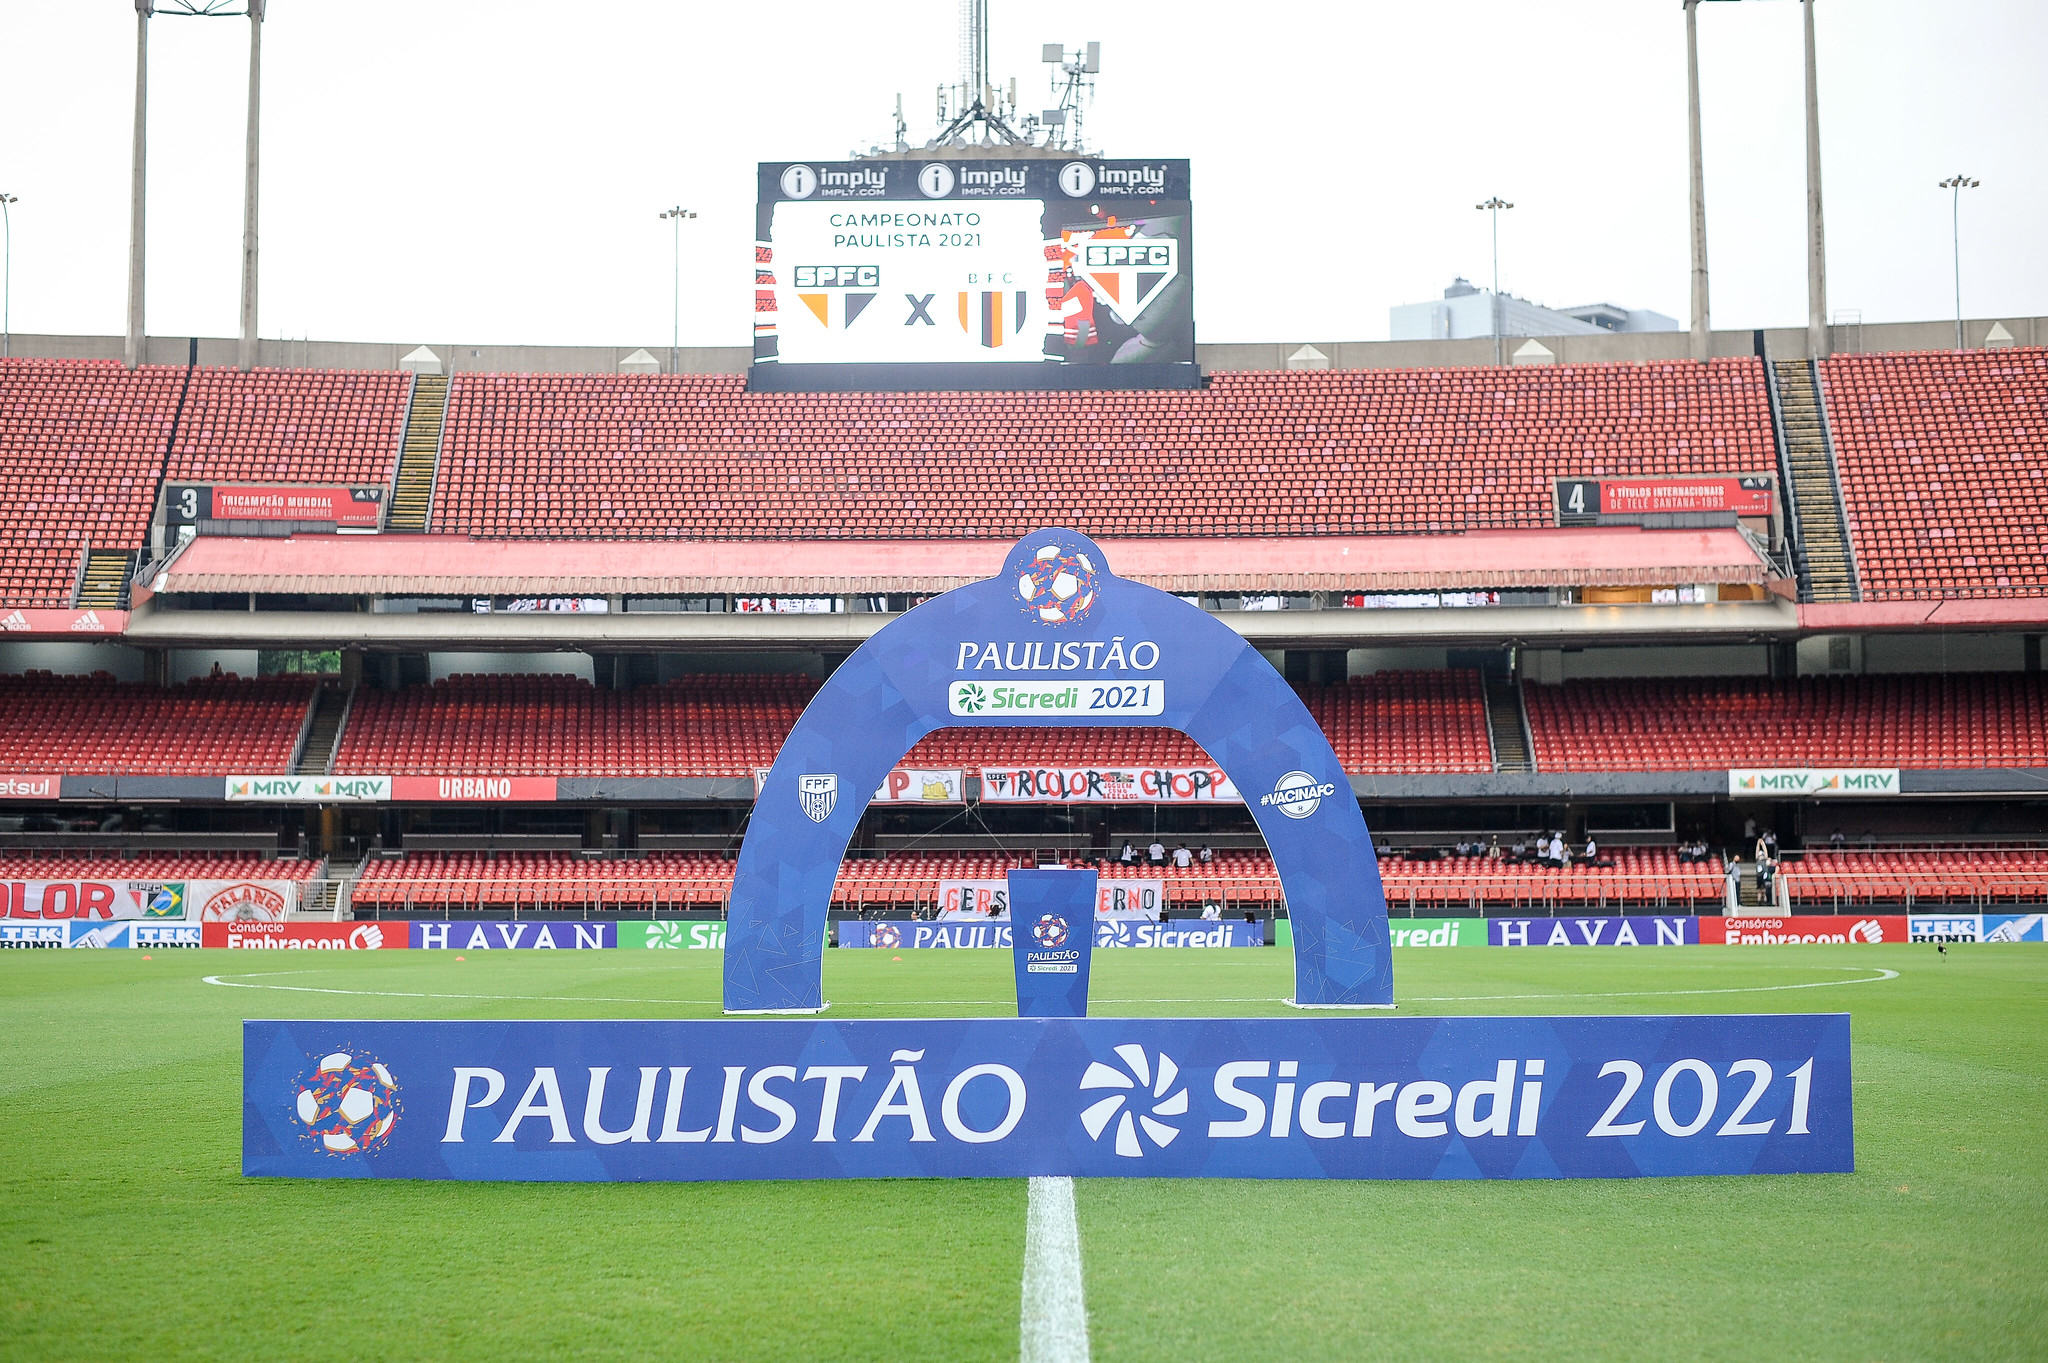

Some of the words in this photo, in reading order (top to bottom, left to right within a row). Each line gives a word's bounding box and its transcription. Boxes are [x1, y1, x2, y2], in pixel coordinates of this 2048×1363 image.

[820, 167, 886, 188] imply
[960, 166, 1027, 188] imply
[1098, 165, 1165, 187] imply
[821, 188, 886, 196] IMPLY.COM
[961, 187, 1026, 195] IMPLY.COM
[1100, 186, 1165, 194] IMPLY.COM
[829, 212, 981, 227] CAMPEONATO
[834, 233, 931, 248] PAULISTA
[938, 233, 981, 247] 2021
[1088, 246, 1168, 265] SPFC
[796, 265, 878, 287] SPFC
[1568, 483, 1585, 514] 4
[1617, 485, 1652, 498] TÍTULOS
[1653, 485, 1725, 497] INTERNACIONAIS
[181, 488, 198, 519] 3
[221, 494, 284, 507] TRICAMPEÃO
[287, 496, 333, 508] MUNDIAL
[955, 635, 1161, 671] PAULISTÃO
[991, 687, 1079, 709] Sicredi
[1089, 684, 1151, 710] 2021
[253, 780, 302, 795] MRV
[336, 780, 384, 795] MRV
[438, 777, 512, 799] URBANO
[805, 778, 832, 790] FPF
[1007, 769, 1104, 800] TRICOLOR
[1140, 769, 1227, 799] CHOPP
[1760, 774, 1809, 789] MRV
[1844, 774, 1893, 789] MRV
[1260, 783, 1335, 807] #VACINAFC
[210, 887, 284, 917] FALANGE
[227, 921, 285, 933] Consórcio
[1724, 917, 1783, 929] Consórcio
[1913, 920, 1971, 934] TEK
[2, 927, 60, 939] TEK
[139, 928, 197, 941] TEK
[419, 923, 606, 949] HAVAN
[913, 926, 1012, 949] PAULIS
[1134, 924, 1234, 948] Sicredi
[1498, 918, 1687, 946] HAVAN
[1725, 930, 1846, 945] Embracon
[227, 933, 346, 949] Embracon
[1027, 949, 1080, 961] PAULISTÃO
[440, 1047, 1028, 1145] PAULISTÃO
[1206, 1057, 1546, 1140] Sicredi
[1585, 1055, 1815, 1139] 2021
